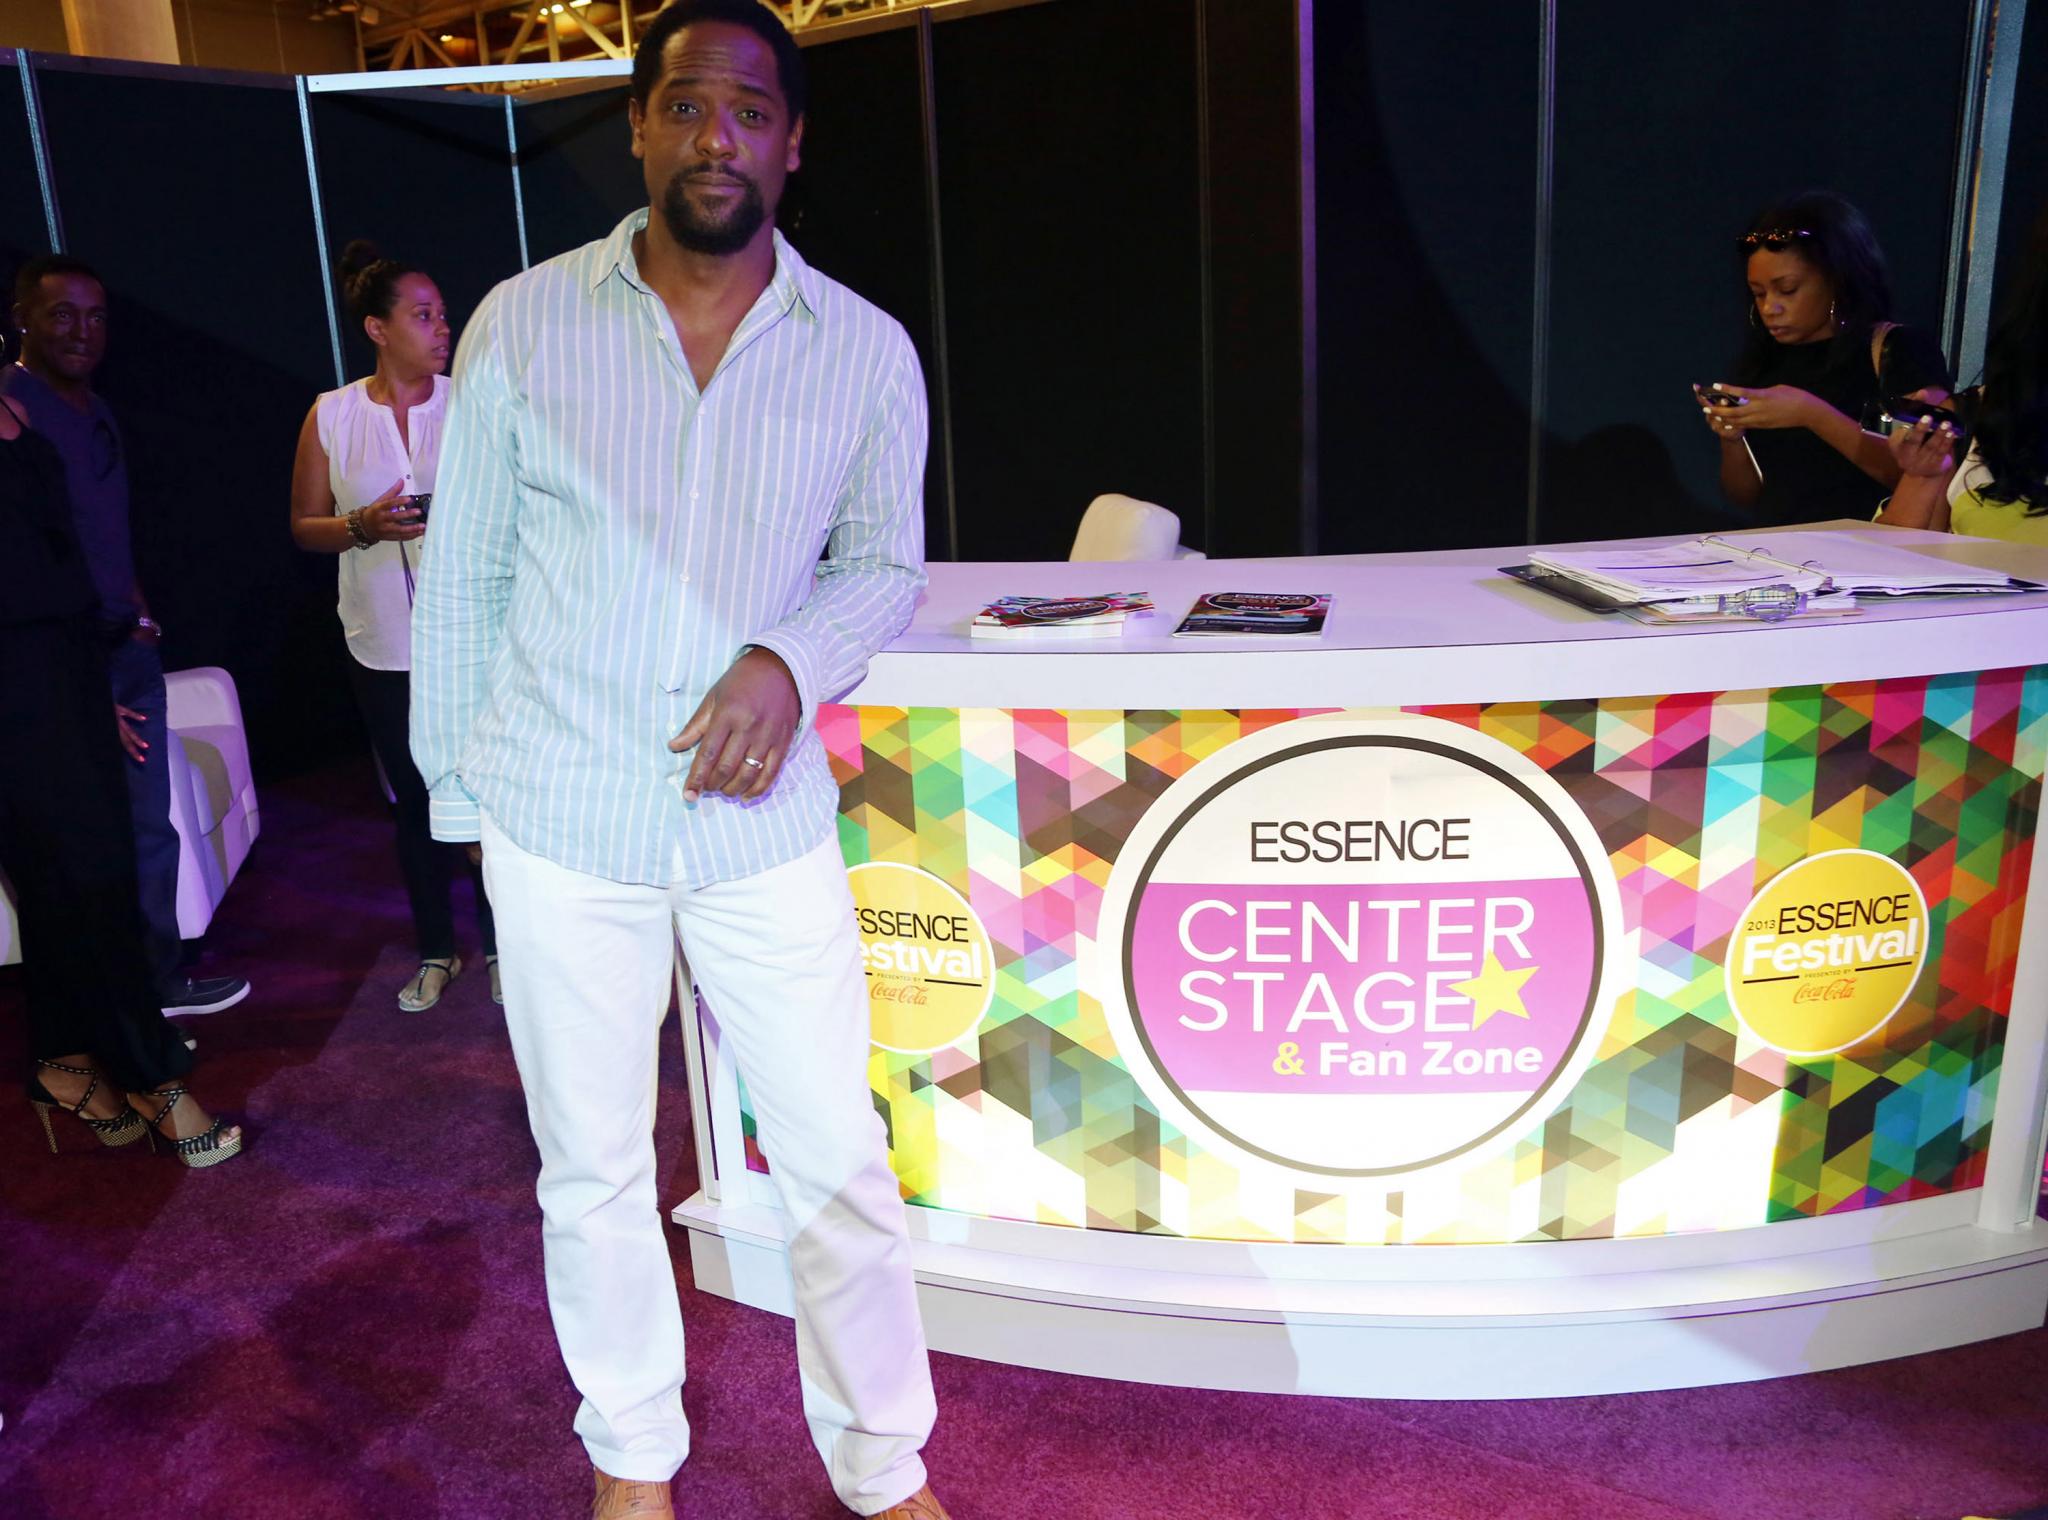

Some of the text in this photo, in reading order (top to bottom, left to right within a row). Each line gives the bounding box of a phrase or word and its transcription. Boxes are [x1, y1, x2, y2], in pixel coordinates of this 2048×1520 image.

[1250, 818, 1471, 863] ESSENCE
[854, 908, 969, 943] SSENCE
[1178, 896, 1535, 963] CENTER
[1747, 893, 1910, 935] 2013 ESSENCE
[859, 940, 983, 980] stival
[1743, 918, 1917, 976] Festival
[1804, 969, 1840, 978] PRESENTED
[1178, 970, 1473, 1034] STAGE
[1272, 1040, 1544, 1077] & Fan Zone
